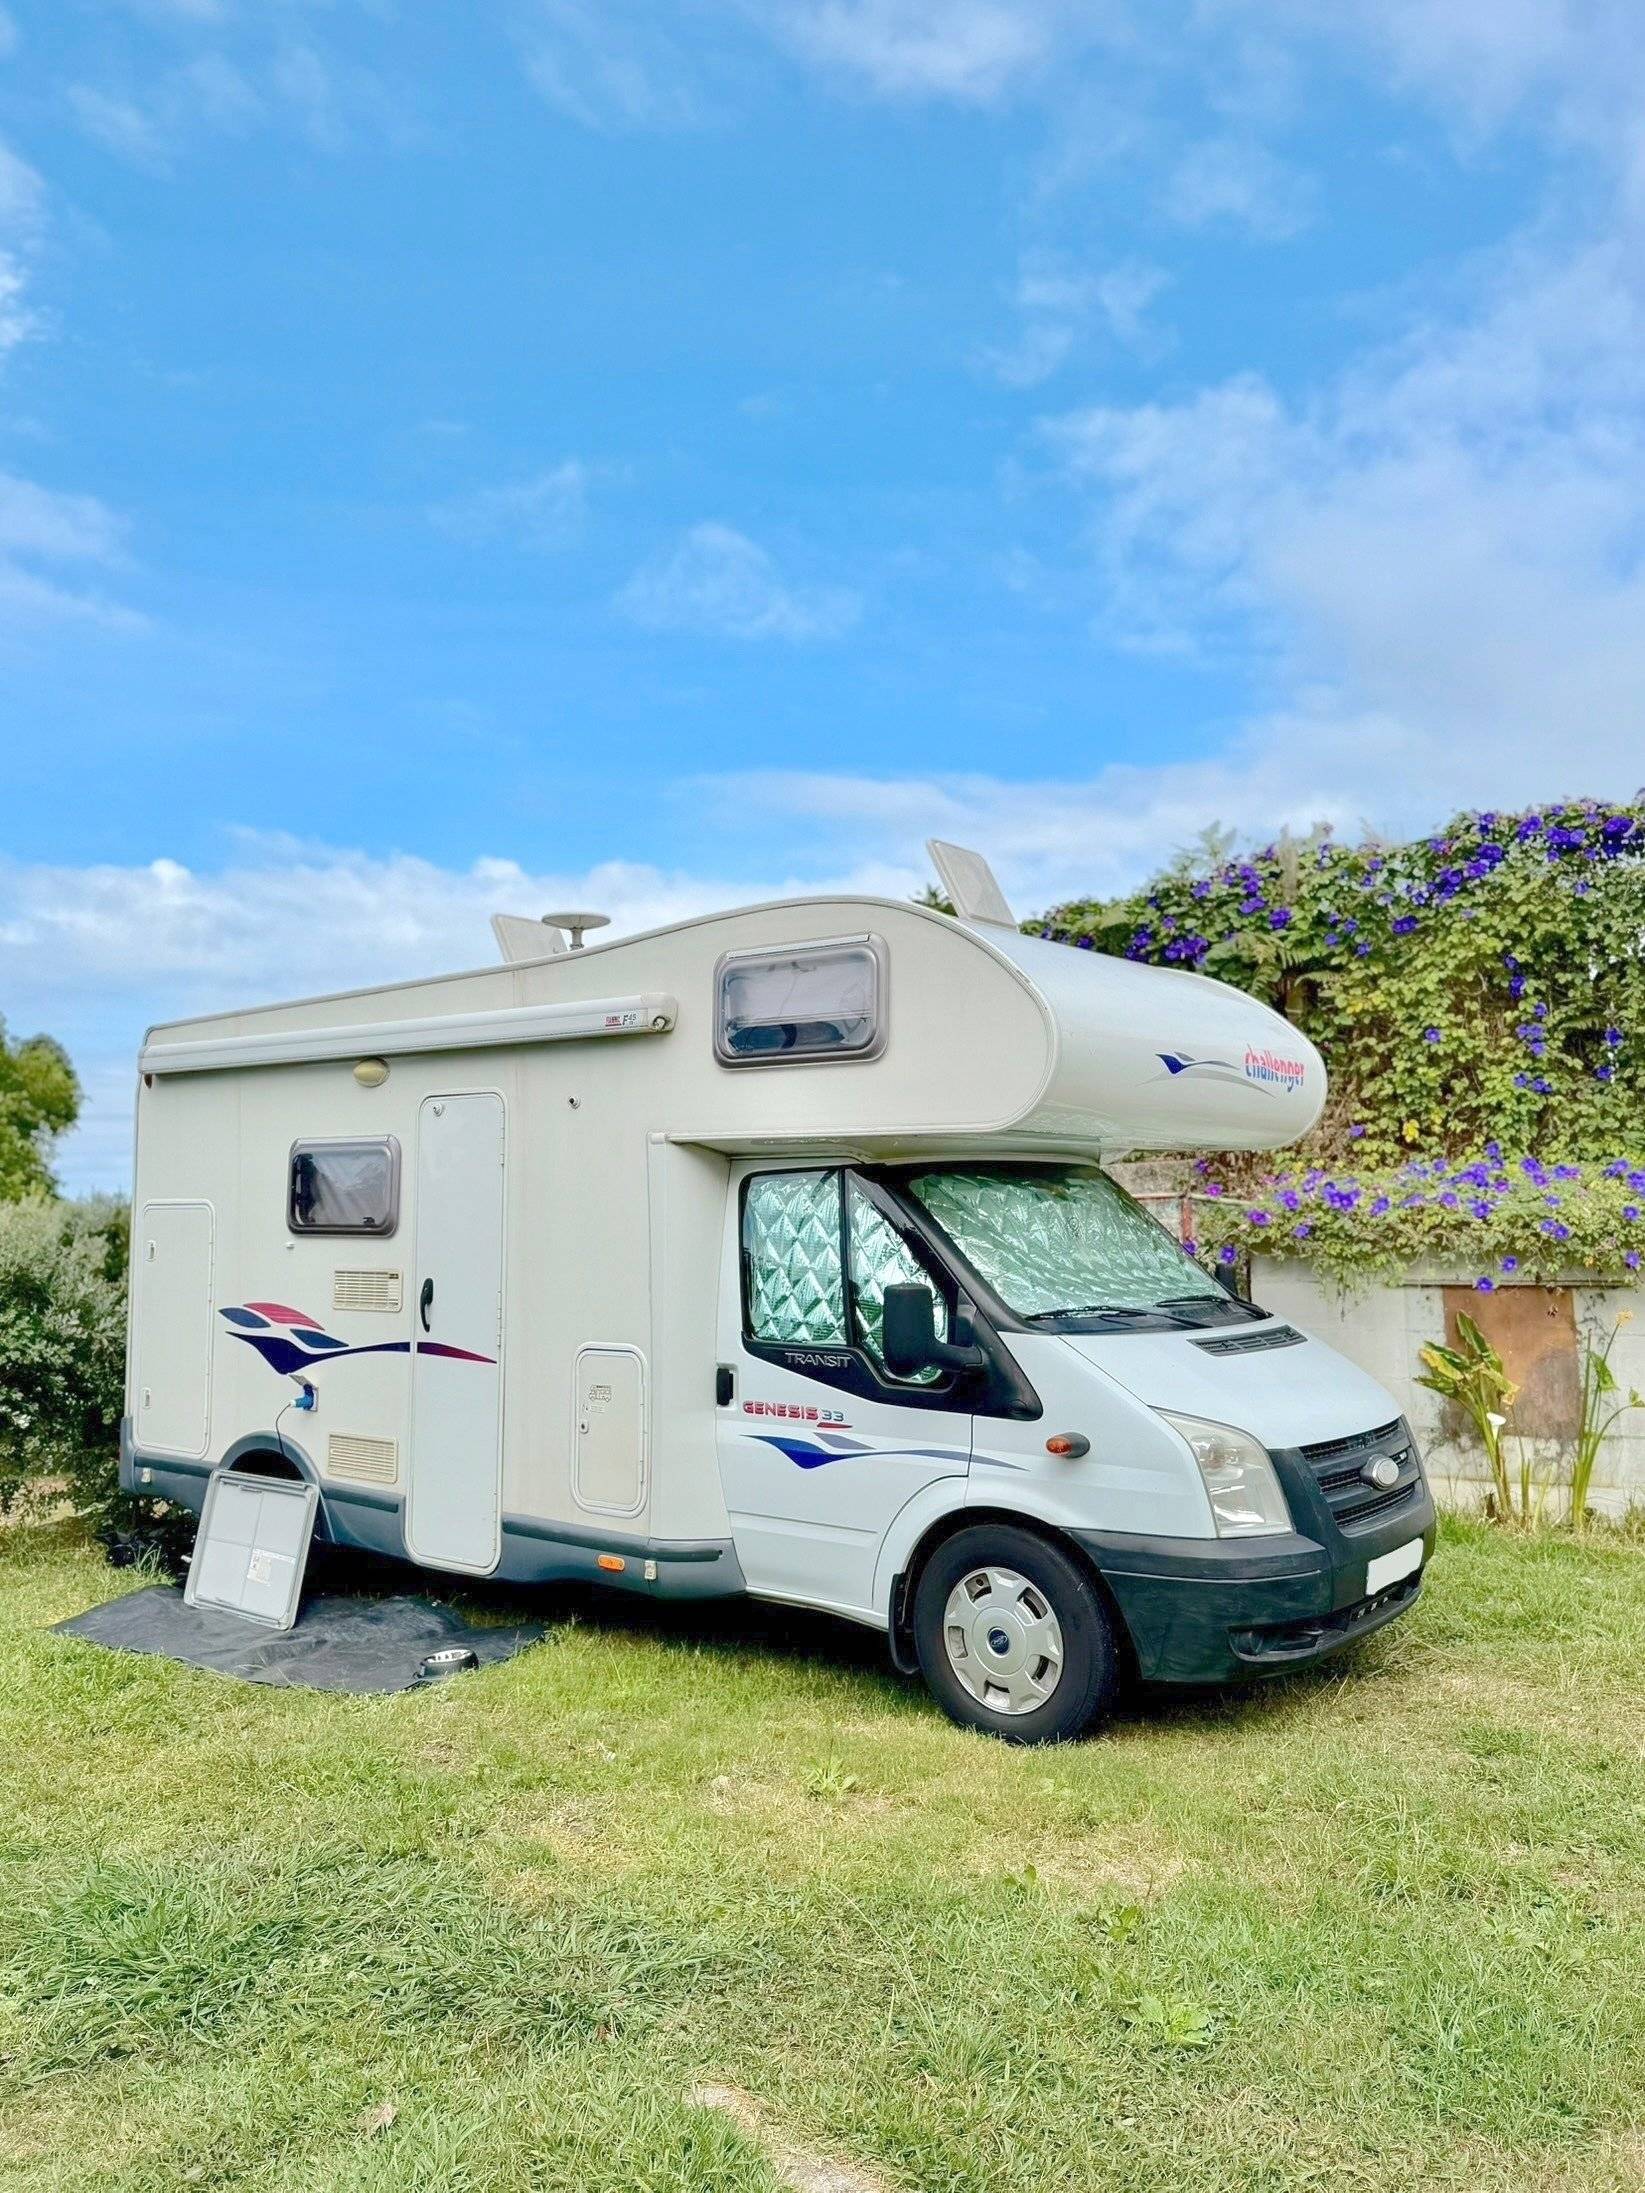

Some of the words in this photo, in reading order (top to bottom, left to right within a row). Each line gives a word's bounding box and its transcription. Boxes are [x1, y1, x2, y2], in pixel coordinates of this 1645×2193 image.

[784, 1352, 851, 1368] TRANSIT
[743, 1401, 819, 1420] GENESIS
[821, 1409, 844, 1422] 33
